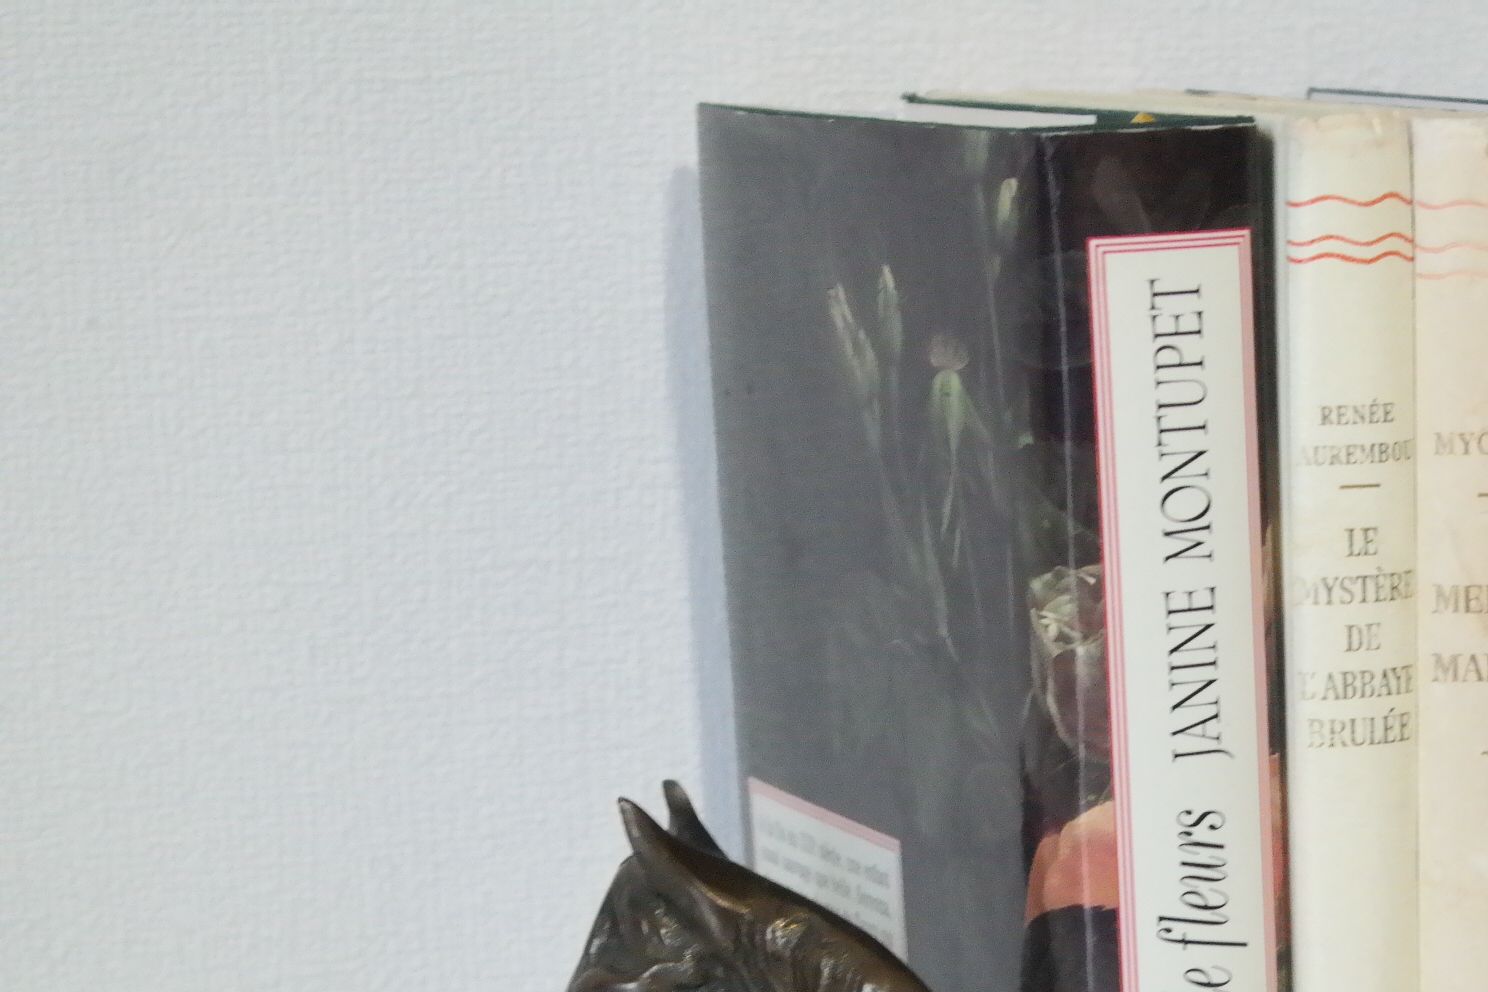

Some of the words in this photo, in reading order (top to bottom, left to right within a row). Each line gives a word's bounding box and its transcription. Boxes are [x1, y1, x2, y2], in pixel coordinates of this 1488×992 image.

[1147, 277, 1213, 563] MONTUPET
[1318, 397, 1395, 426] RENÉE
[1344, 526, 1378, 558] LE
[1343, 622, 1382, 653] DE
[1164, 585, 1233, 761] JANINE
[1306, 707, 1411, 749] BRULÉE
[1156, 808, 1249, 949] fleurs
